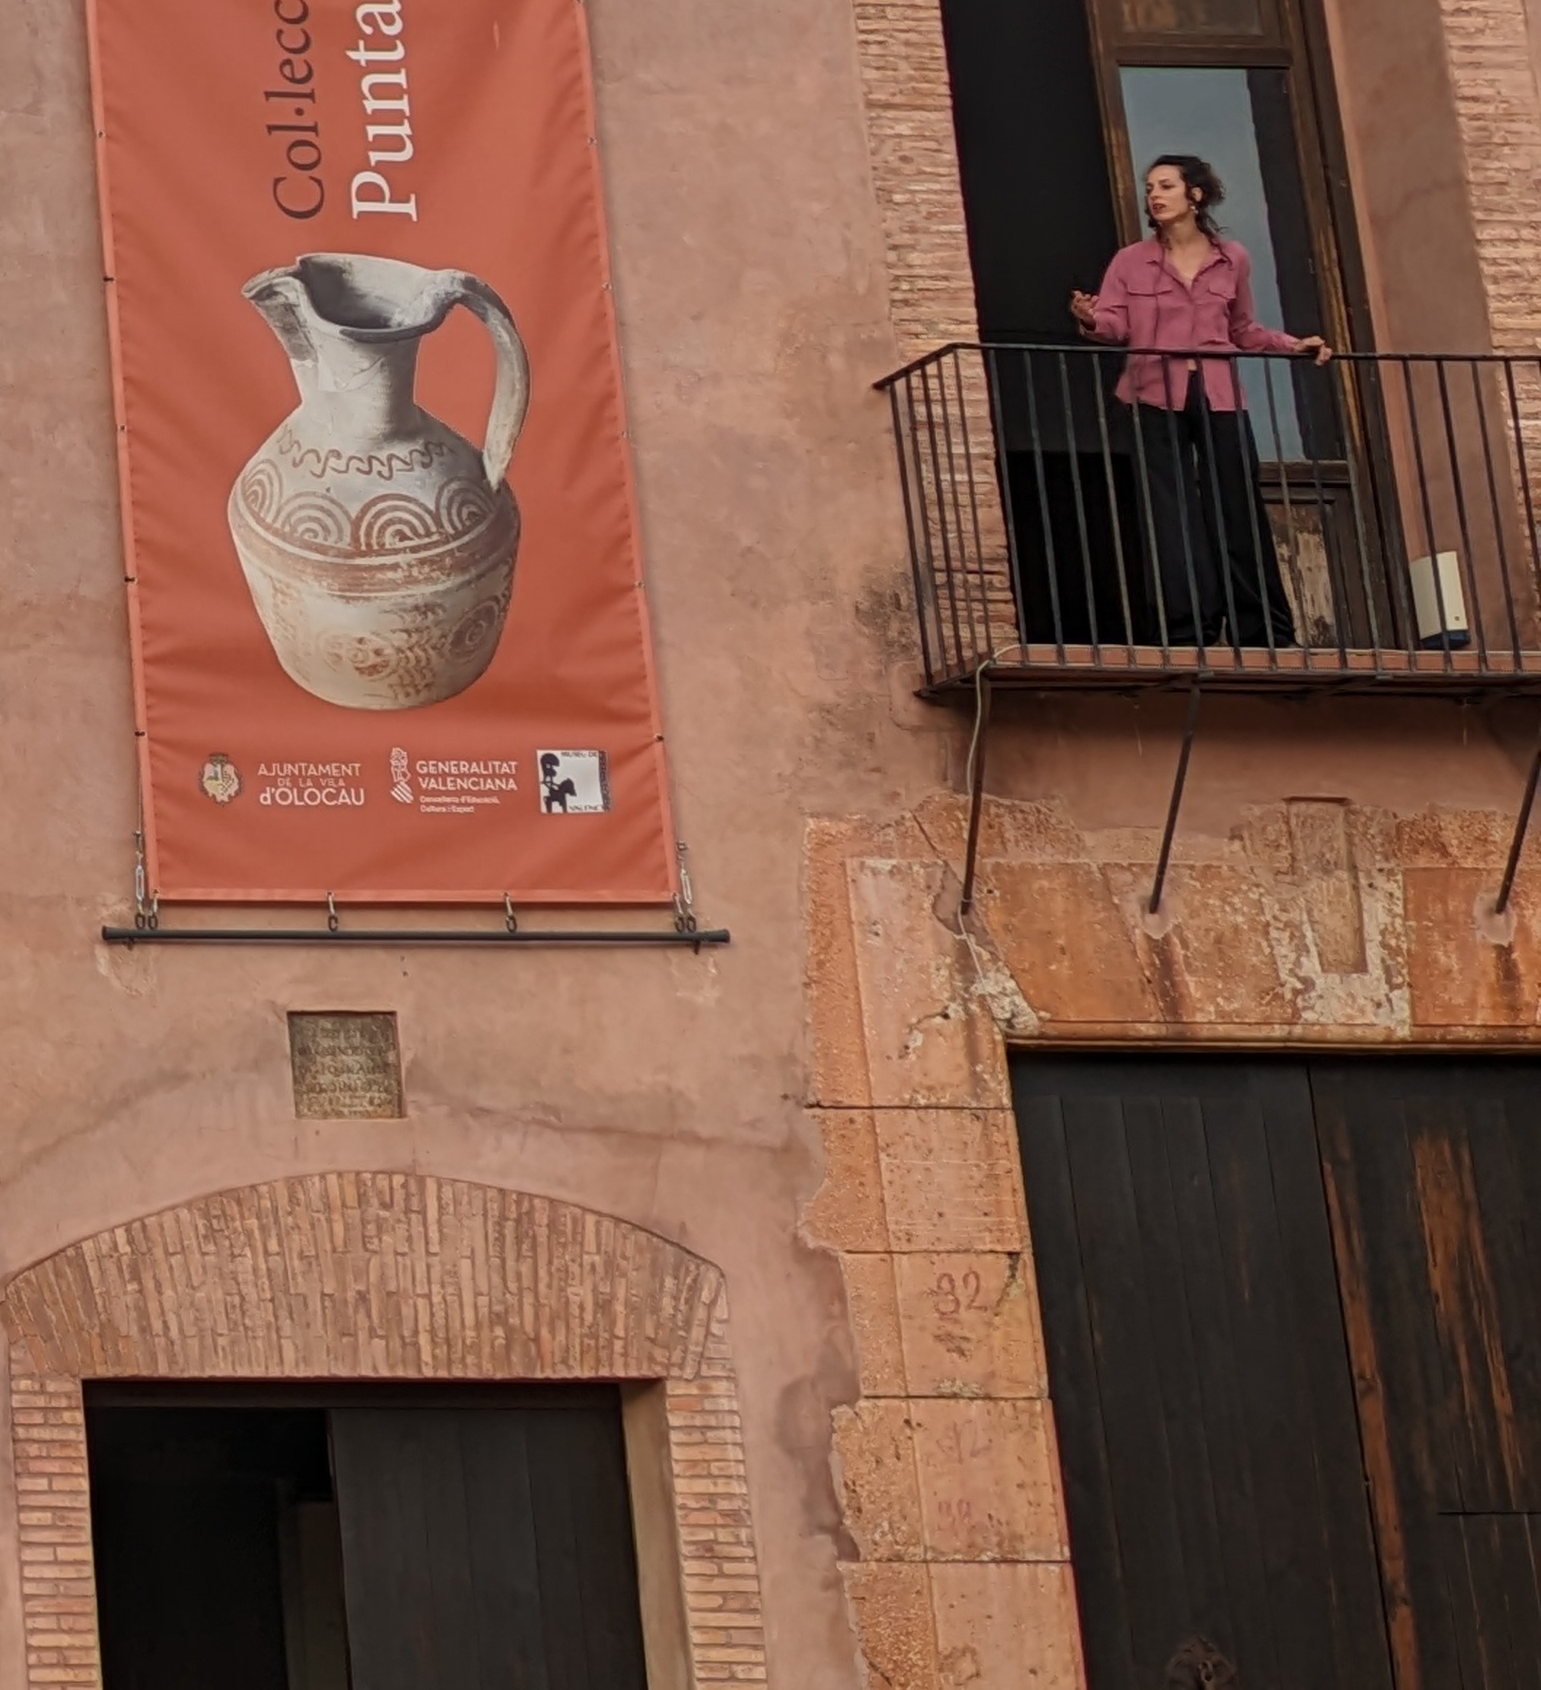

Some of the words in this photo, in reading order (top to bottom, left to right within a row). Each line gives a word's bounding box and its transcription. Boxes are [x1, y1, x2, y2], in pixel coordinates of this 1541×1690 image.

[257, 763, 362, 776] AJUNTAMENT
[416, 760, 518, 774] GENERALITAT
[298, 777, 314, 787] LA
[418, 776, 518, 790] VALENCIANA
